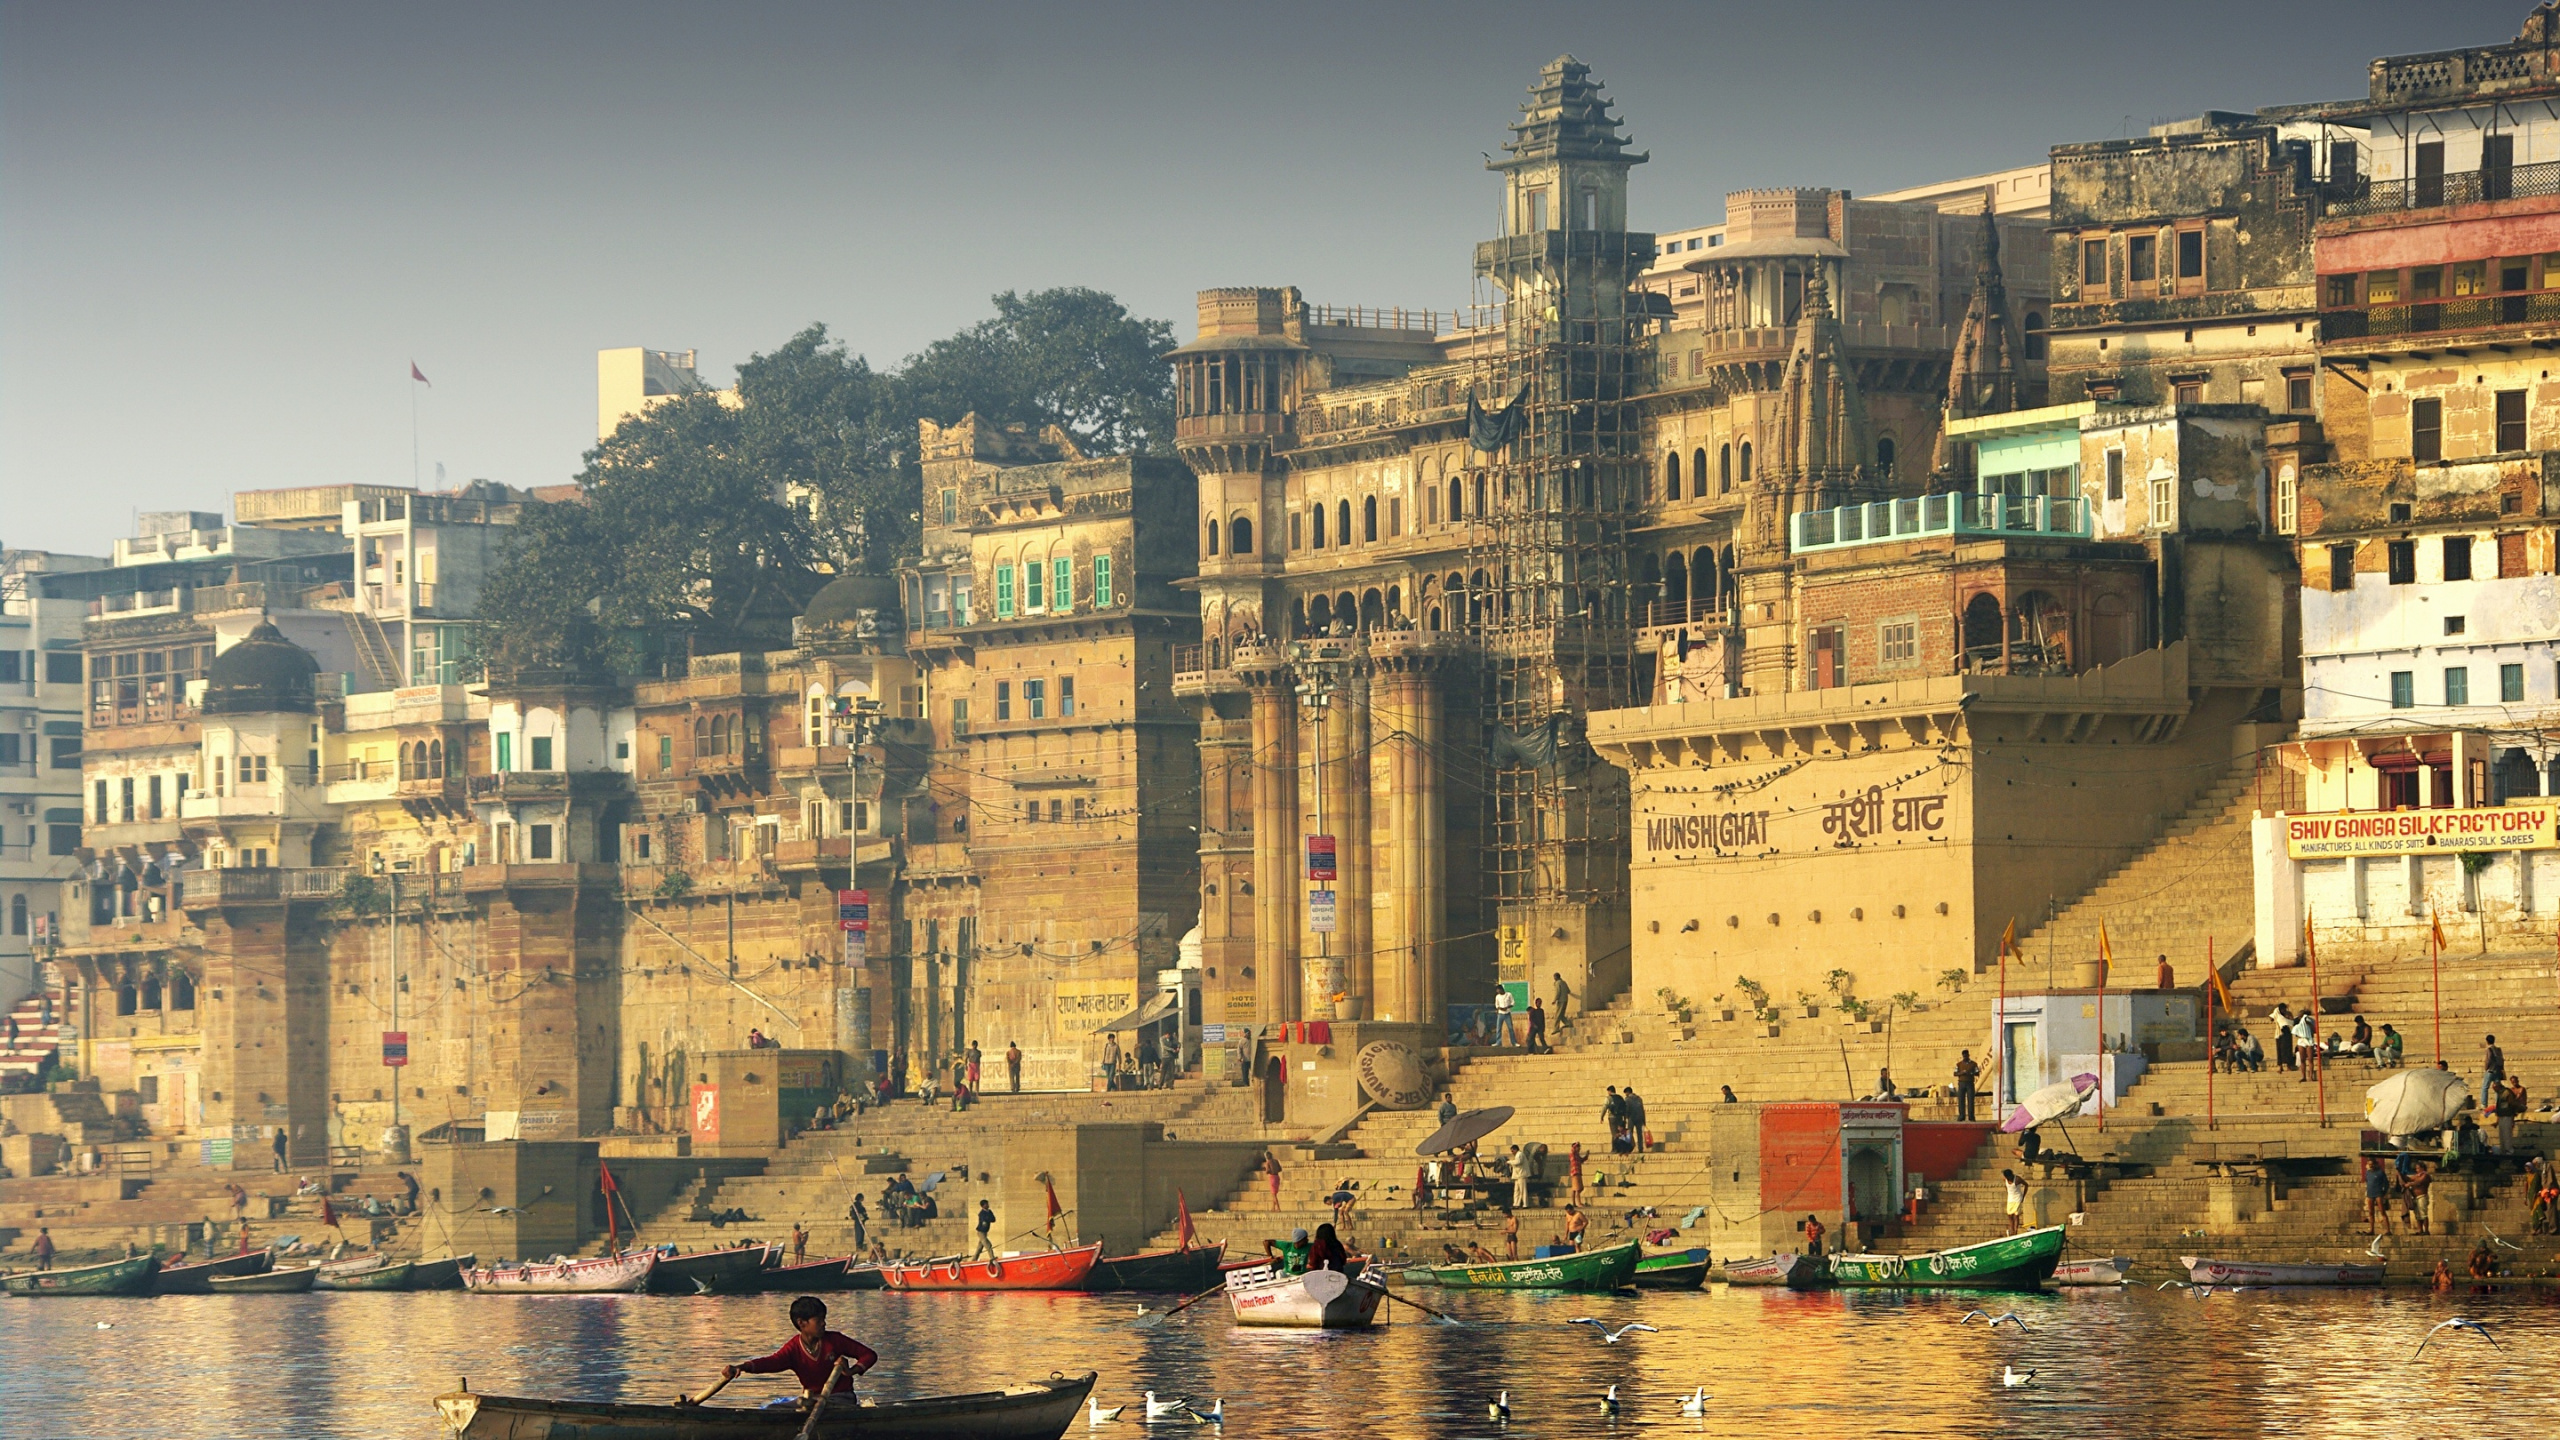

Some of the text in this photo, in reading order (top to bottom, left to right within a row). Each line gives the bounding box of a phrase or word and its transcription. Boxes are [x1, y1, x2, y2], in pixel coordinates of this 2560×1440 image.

[394, 686, 437, 699] SUNRISE
[1647, 810, 1769, 851] MUNSHIGHAT
[1821, 785, 1948, 848] मुंशी घाट
[2290, 810, 2545, 840] SHIV GANGA SILK FACTORY
[2301, 834, 2535, 853] MANUFACTURES ALL KINDS OF SUITS BANARASI SILK SAREES
